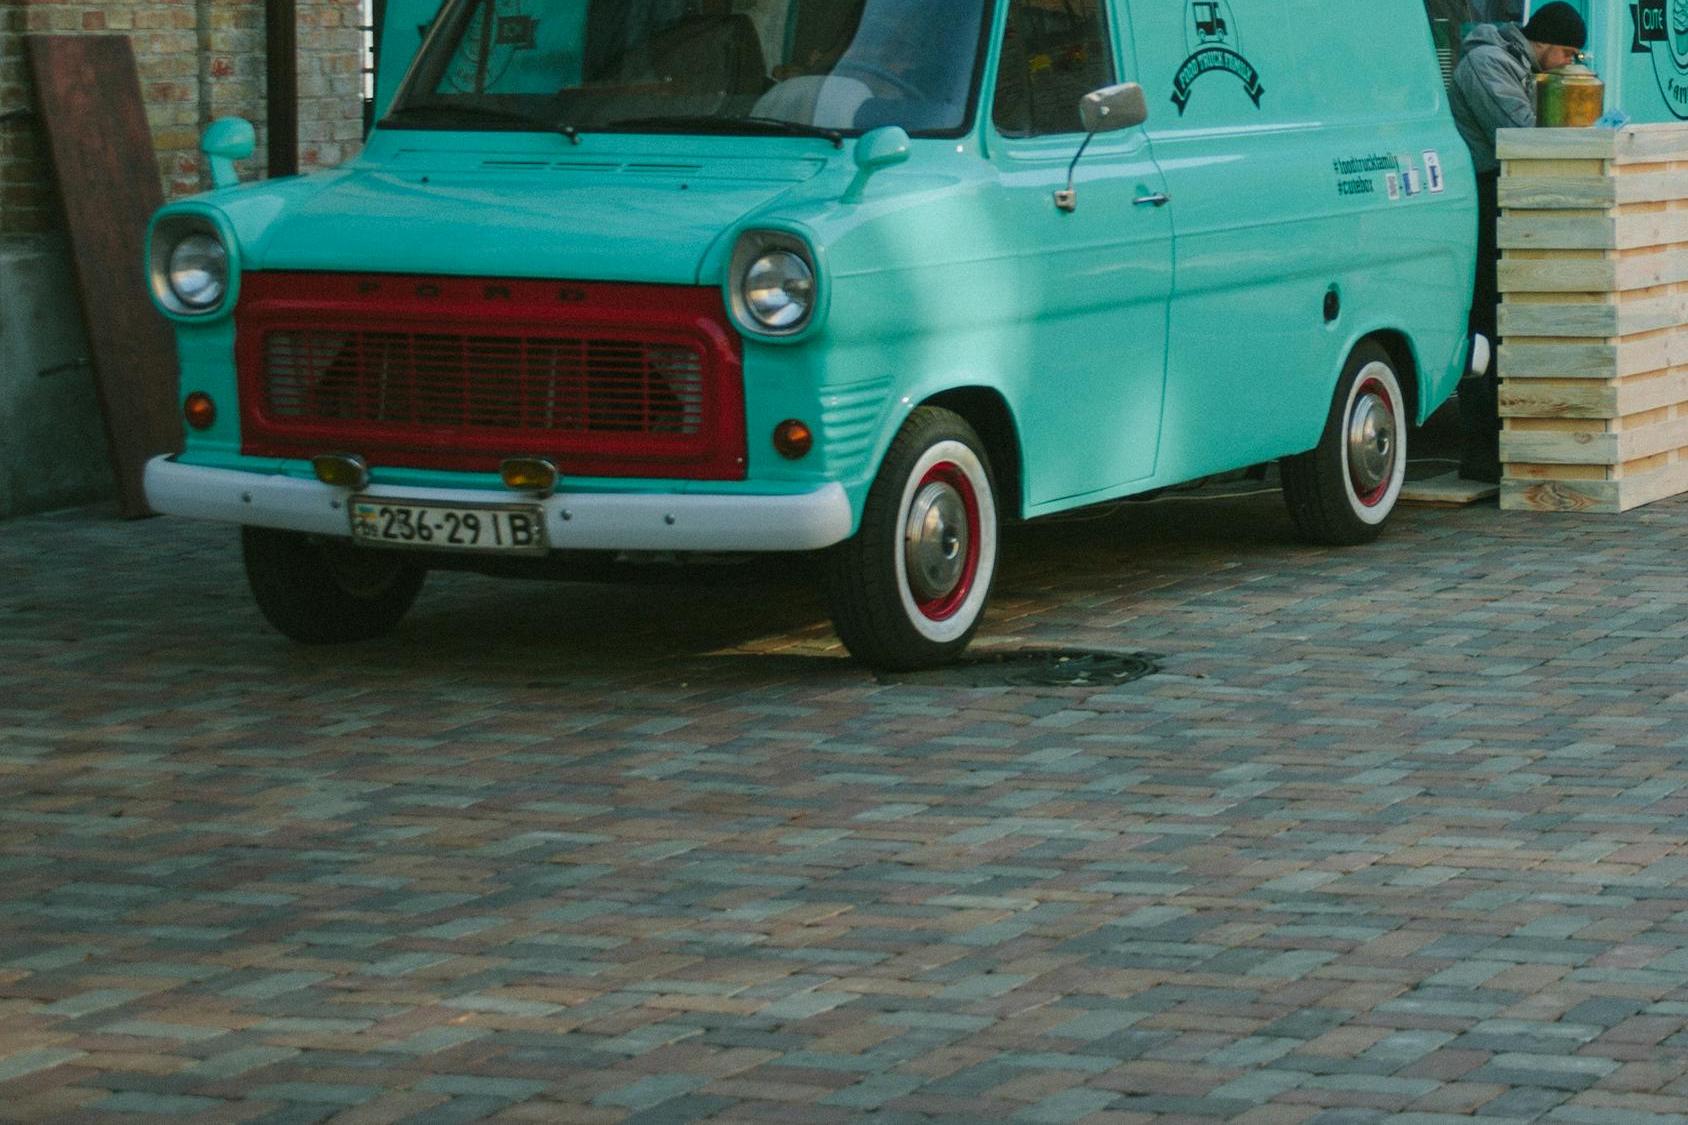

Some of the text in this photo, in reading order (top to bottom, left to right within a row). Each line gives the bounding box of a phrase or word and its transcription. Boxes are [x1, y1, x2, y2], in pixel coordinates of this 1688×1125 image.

[1643, 8, 1664, 30] CUTE
[356, 281, 588, 303] FORD
[379, 506, 481, 544] 236-29
